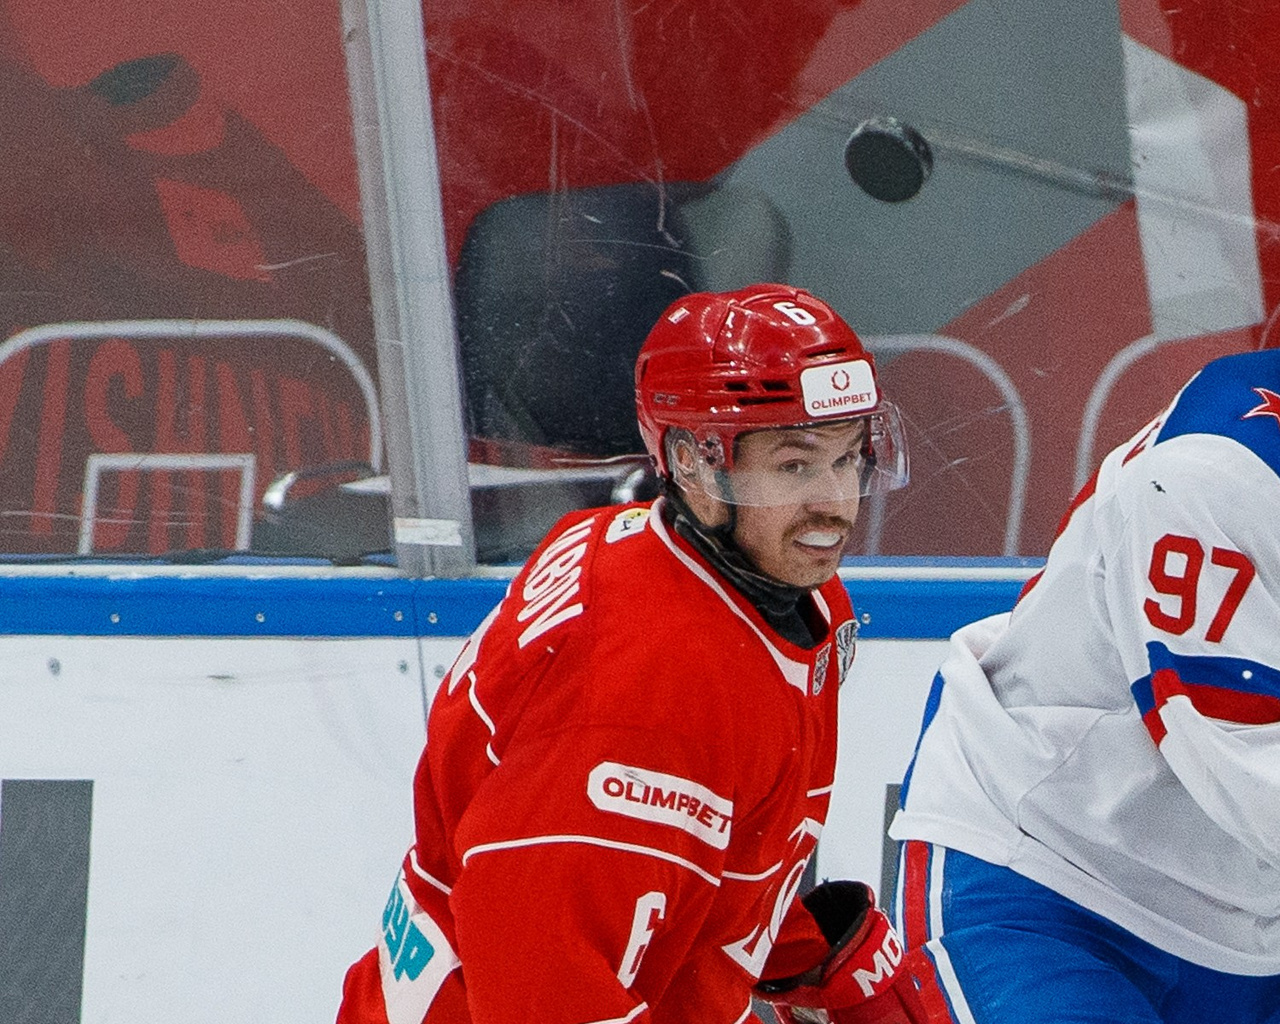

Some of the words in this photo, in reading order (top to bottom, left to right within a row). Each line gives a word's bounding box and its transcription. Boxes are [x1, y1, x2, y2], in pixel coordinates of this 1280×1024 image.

[773, 301, 817, 326] 6
[811, 391, 873, 411] OLIMPBET
[1143, 533, 1256, 644] 97
[602, 776, 733, 834] OLIMPBET
